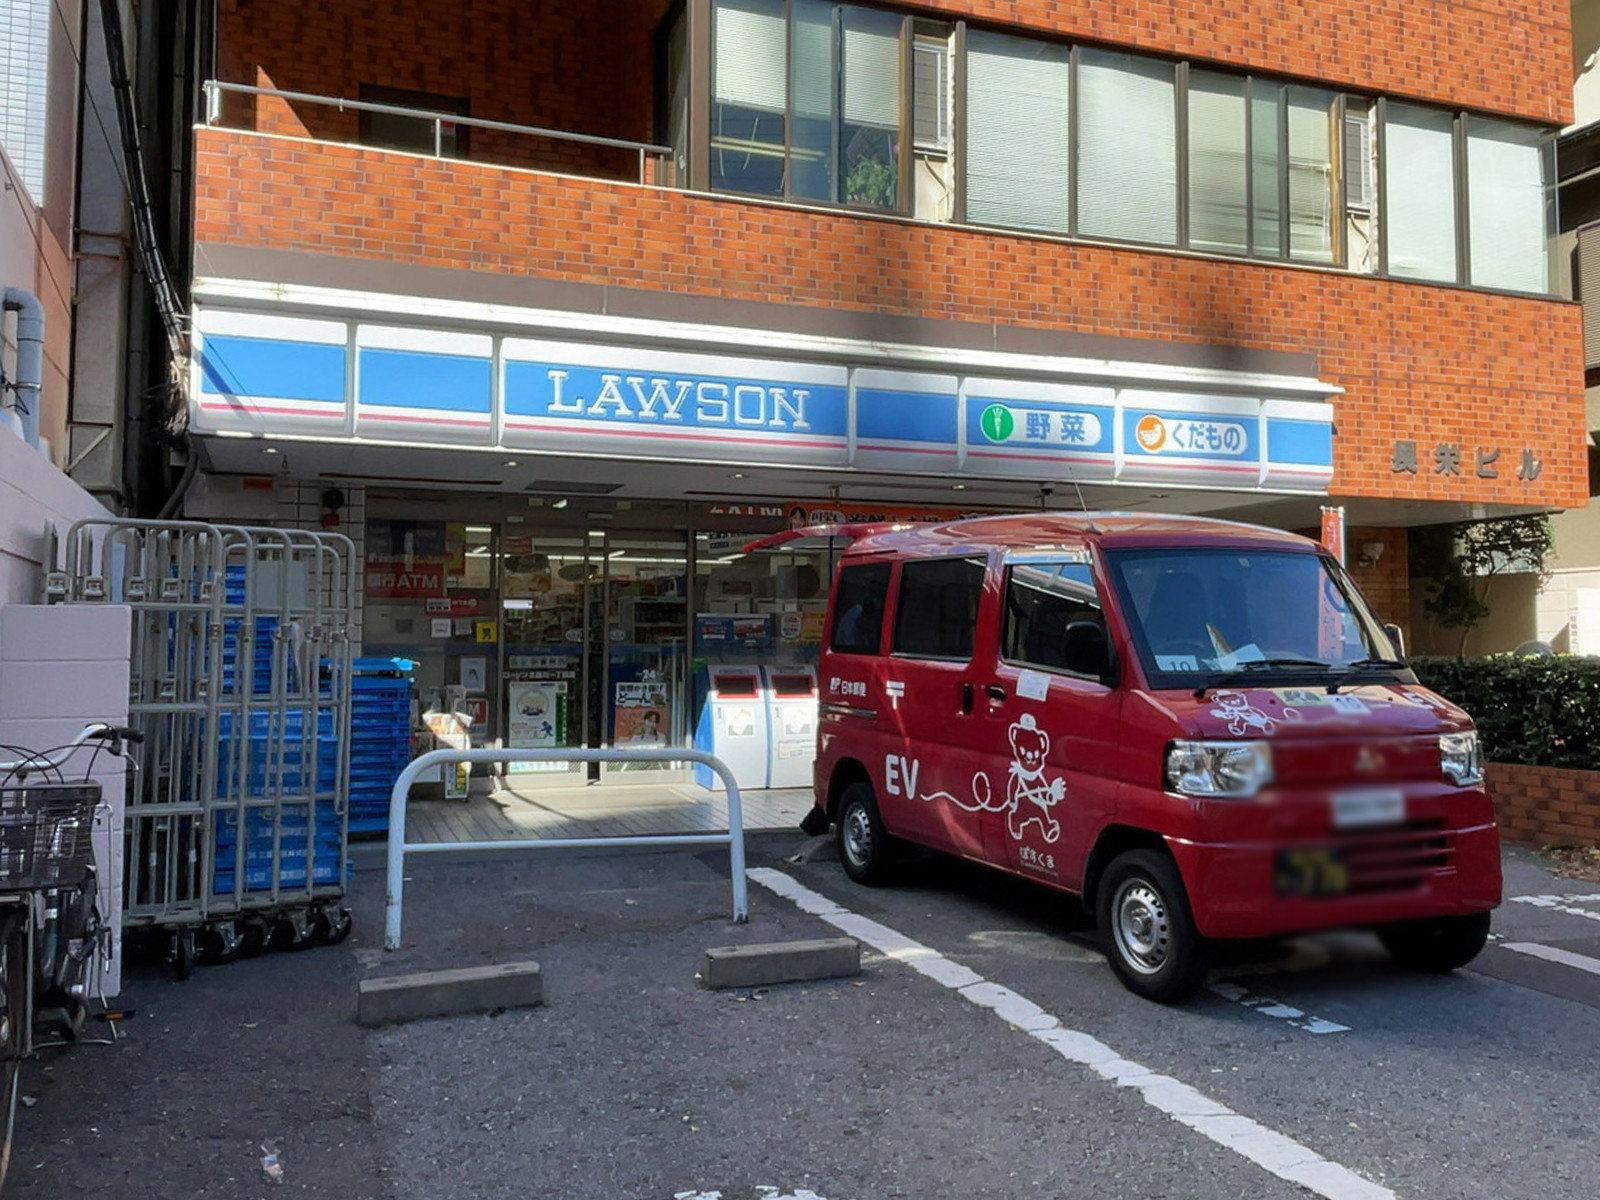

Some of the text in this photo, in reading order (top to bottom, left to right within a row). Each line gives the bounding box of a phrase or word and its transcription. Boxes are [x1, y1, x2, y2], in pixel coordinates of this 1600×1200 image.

[547, 369, 811, 430] LAWSON
[1025, 411, 1086, 443] 野菜
[1171, 421, 1242, 451] くだもの
[885, 753, 920, 800] EV
